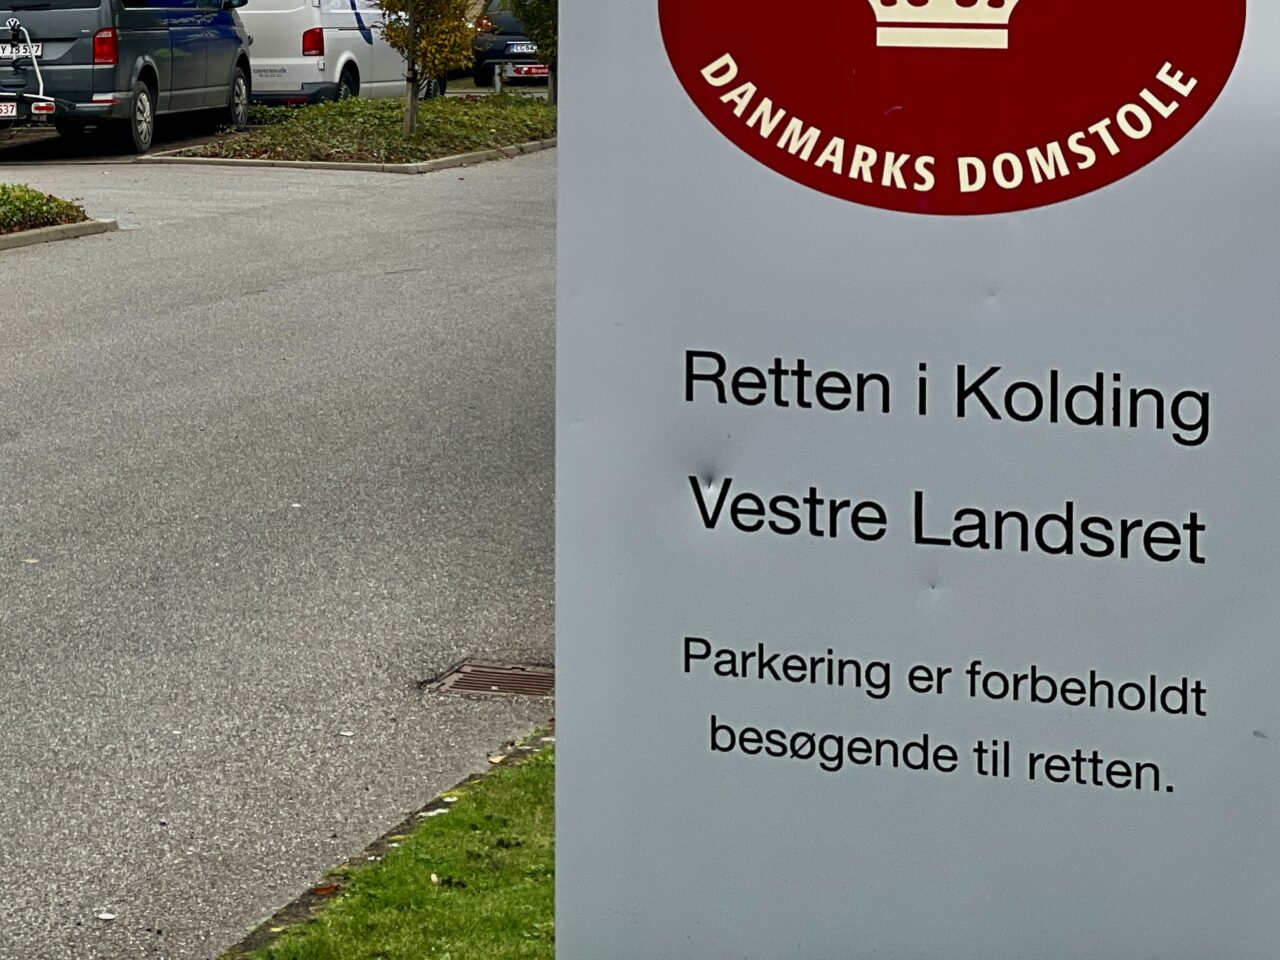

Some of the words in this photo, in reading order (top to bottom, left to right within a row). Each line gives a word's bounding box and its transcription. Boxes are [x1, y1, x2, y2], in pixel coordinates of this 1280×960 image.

[701, 53, 935, 192] DANMARKS
[958, 61, 1198, 193] DOMSTOLE
[684, 350, 890, 414] Retten
[918, 362, 927, 416] i
[956, 364, 1211, 447] Kolding
[688, 475, 888, 542] Vestre
[914, 490, 1207, 564] Landsret
[683, 636, 891, 700] Parkering
[908, 665, 952, 695] er
[965, 660, 1208, 717] forbeholdt
[710, 714, 958, 773] besøgende
[973, 740, 1010, 778] til
[1029, 749, 1175, 793] retten.
